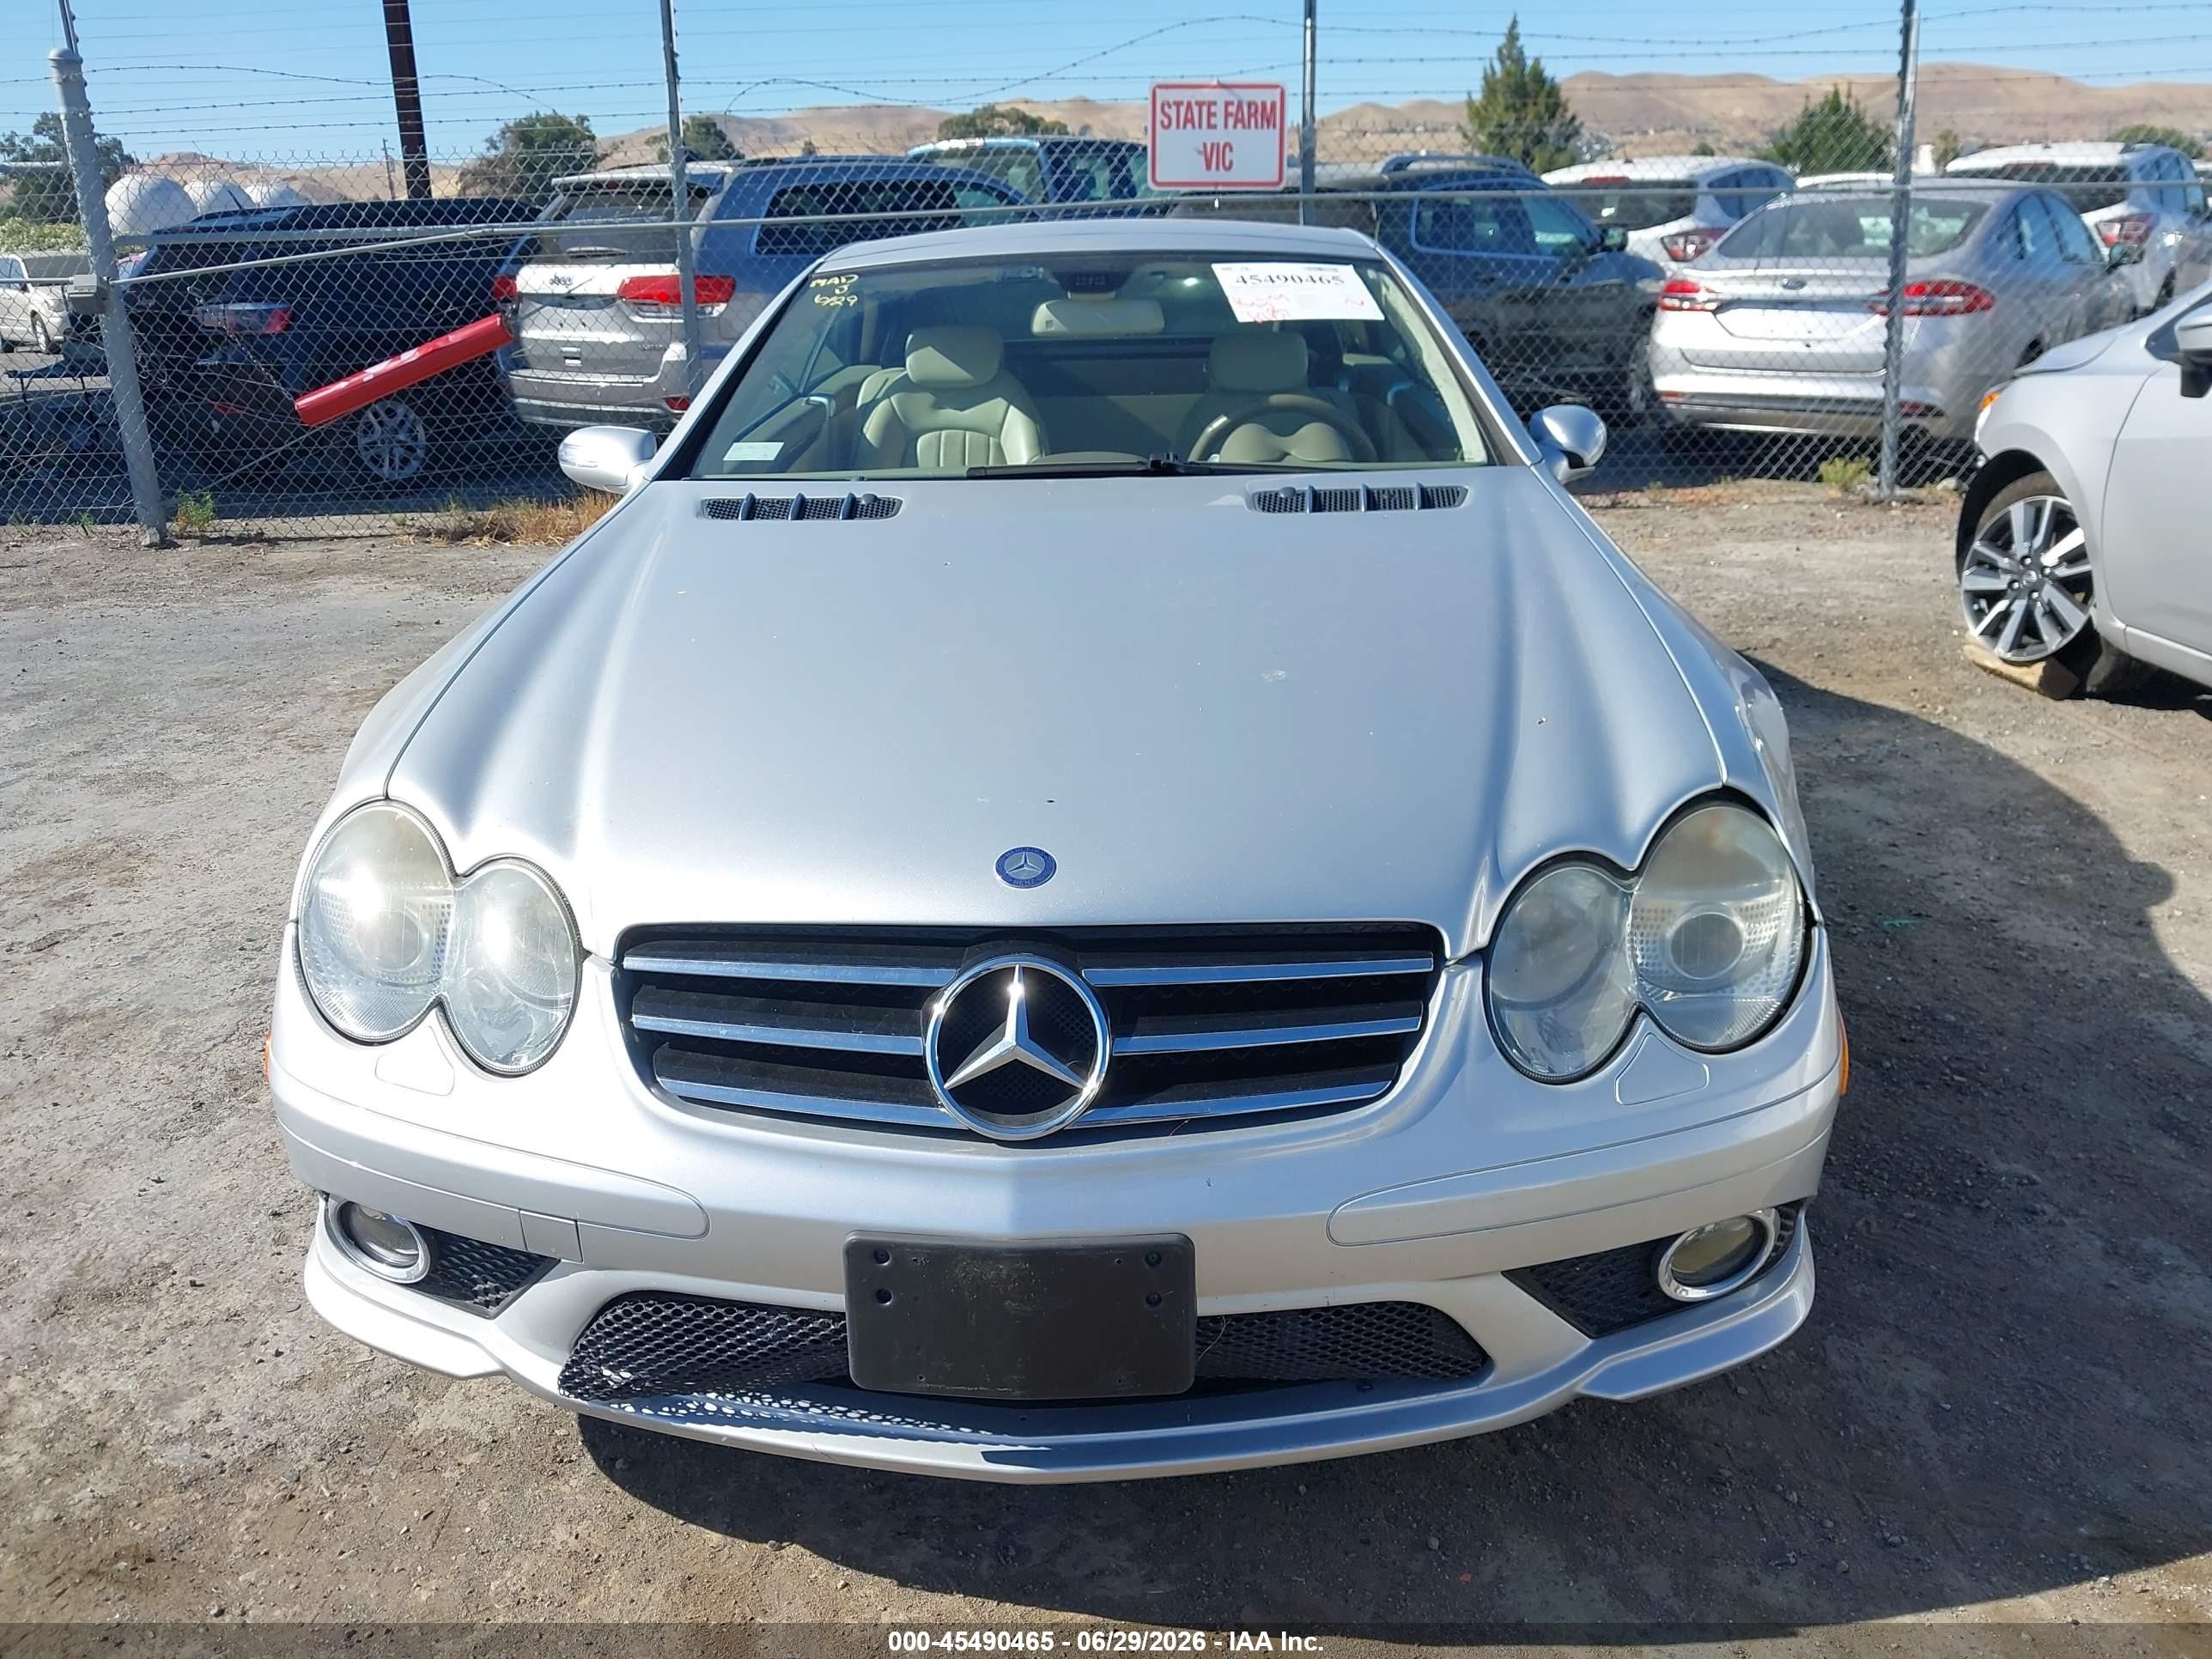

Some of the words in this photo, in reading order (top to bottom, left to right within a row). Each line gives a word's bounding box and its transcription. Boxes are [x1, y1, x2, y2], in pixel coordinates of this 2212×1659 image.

[1160, 100, 1218, 130] STATE
[1224, 100, 1277, 130] FARM
[1202, 141, 1234, 172] VIC
[1236, 274, 1346, 286] 45490465
